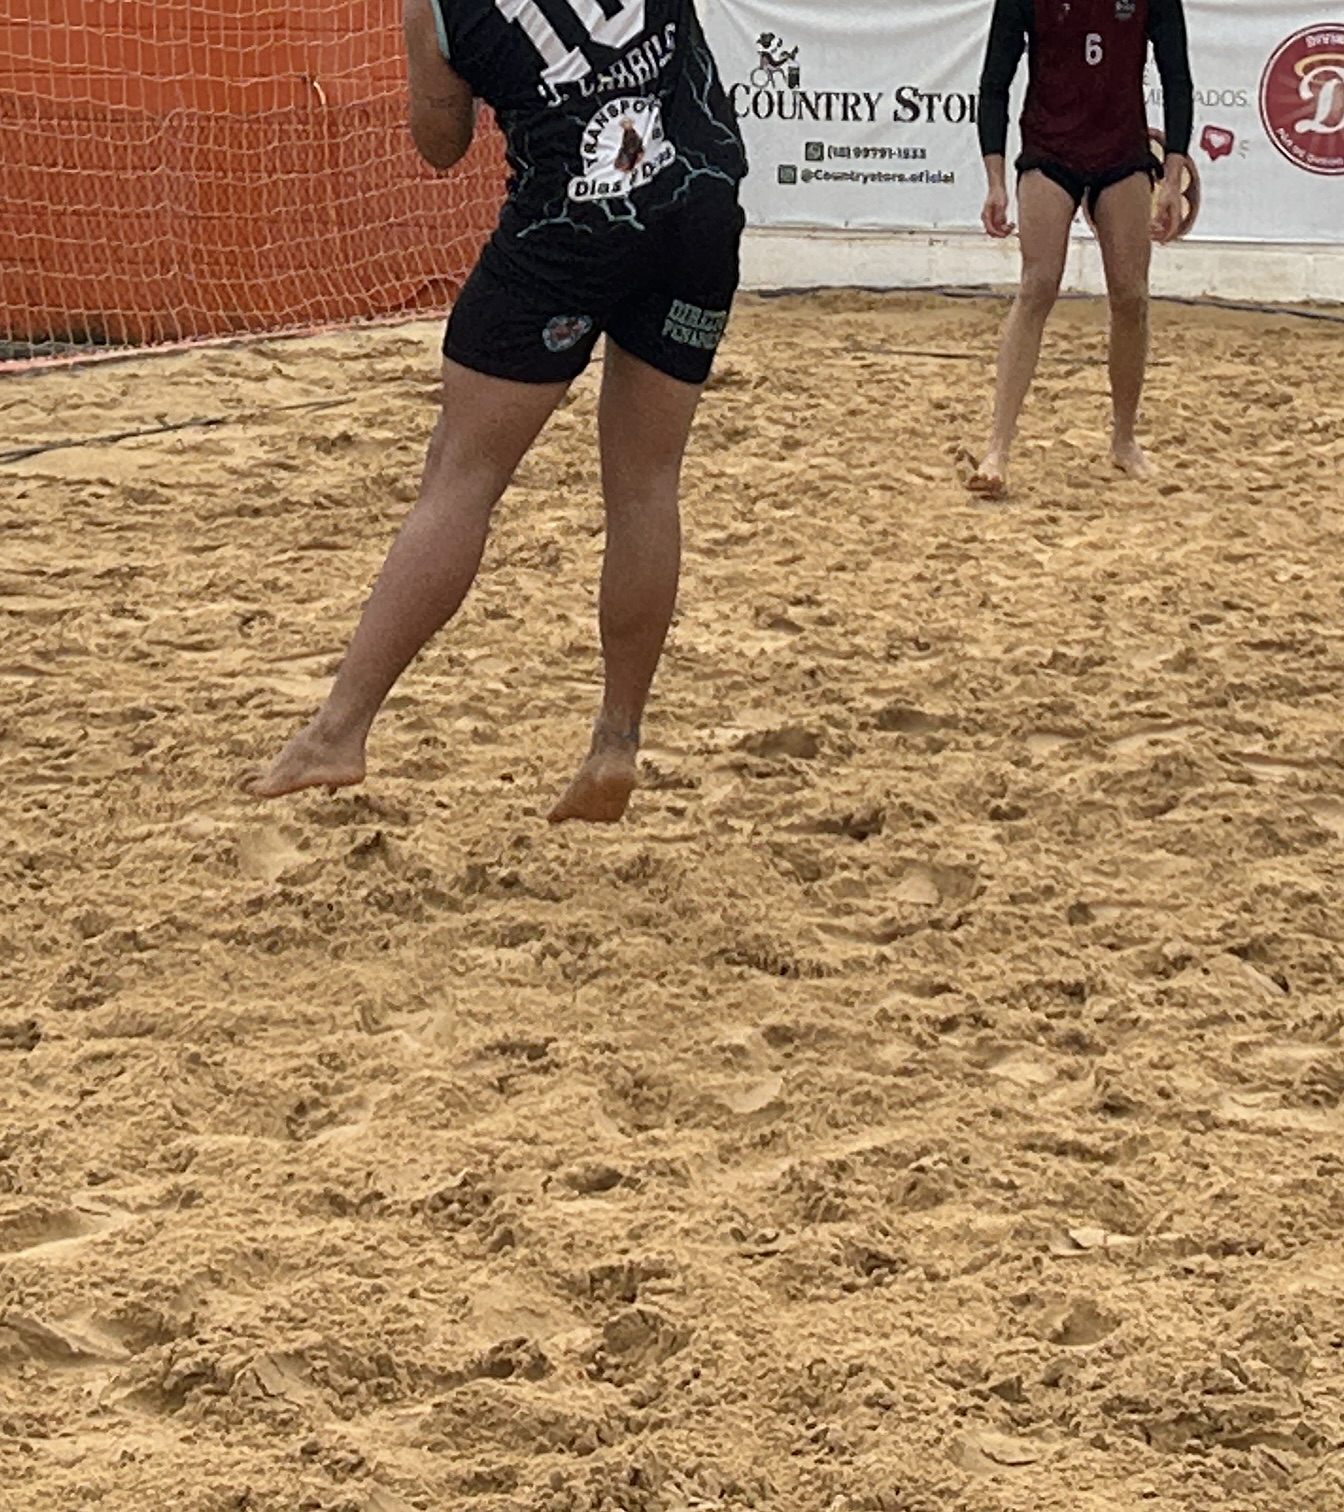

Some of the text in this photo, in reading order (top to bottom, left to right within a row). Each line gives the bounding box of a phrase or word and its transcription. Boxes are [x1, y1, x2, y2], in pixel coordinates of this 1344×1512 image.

[1085, 33, 1103, 65] 6
[730, 83, 977, 123] COUNTRY STO
